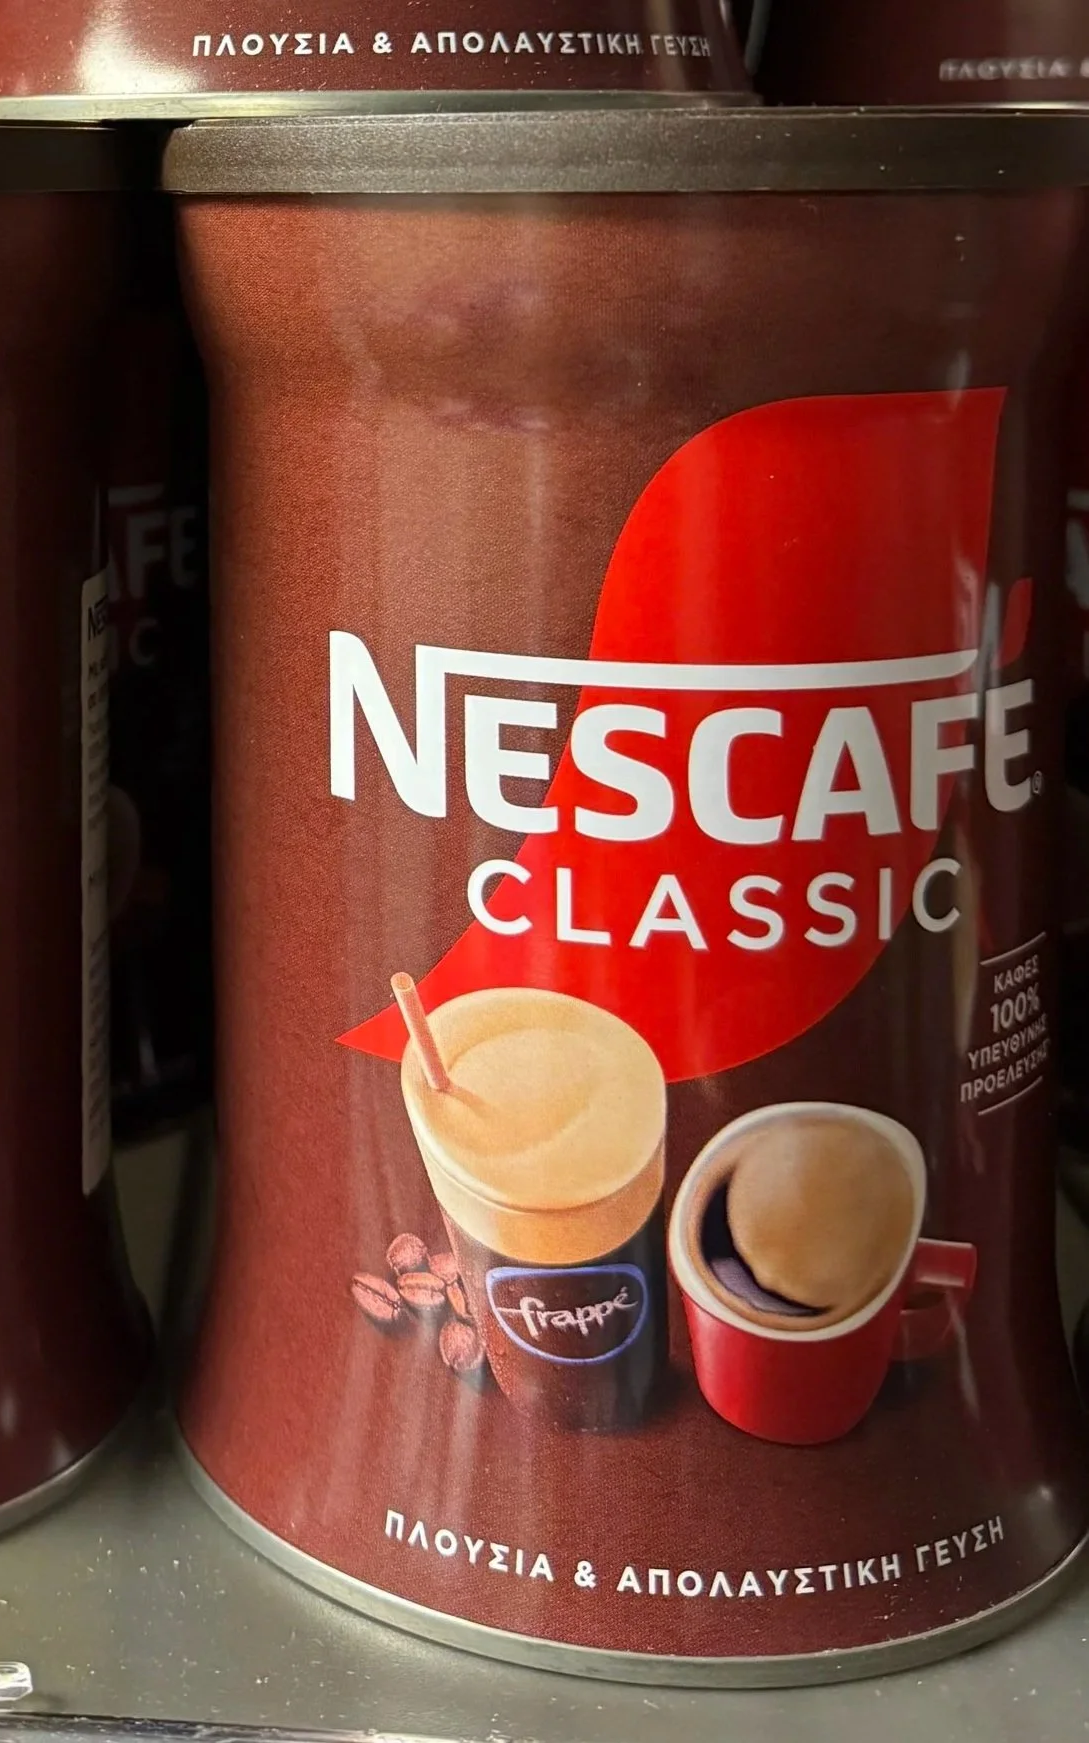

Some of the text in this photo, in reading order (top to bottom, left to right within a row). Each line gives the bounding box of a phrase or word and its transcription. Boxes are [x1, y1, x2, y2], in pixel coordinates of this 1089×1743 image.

[192, 31, 711, 57] ΠΛΟΥΣΙΑ & ΑΠΟΛΑΥΣΤΙΚΗ ΓΕΥΣΗ
[467, 859, 961, 951] CLASSIC
[994, 955, 1039, 993] ΚΑΦΕΣ
[990, 982, 1040, 1033] 100%
[968, 1013, 1047, 1070] ΥΠΕΥΘΥΝΗΣ
[496, 1286, 638, 1341] frappé
[385, 1509, 1004, 1597] ΠΛΟΥΣΙΑ & ΑΠΟΛΑΥΣΤΙΚΗ ΓΕΥΣΗ
